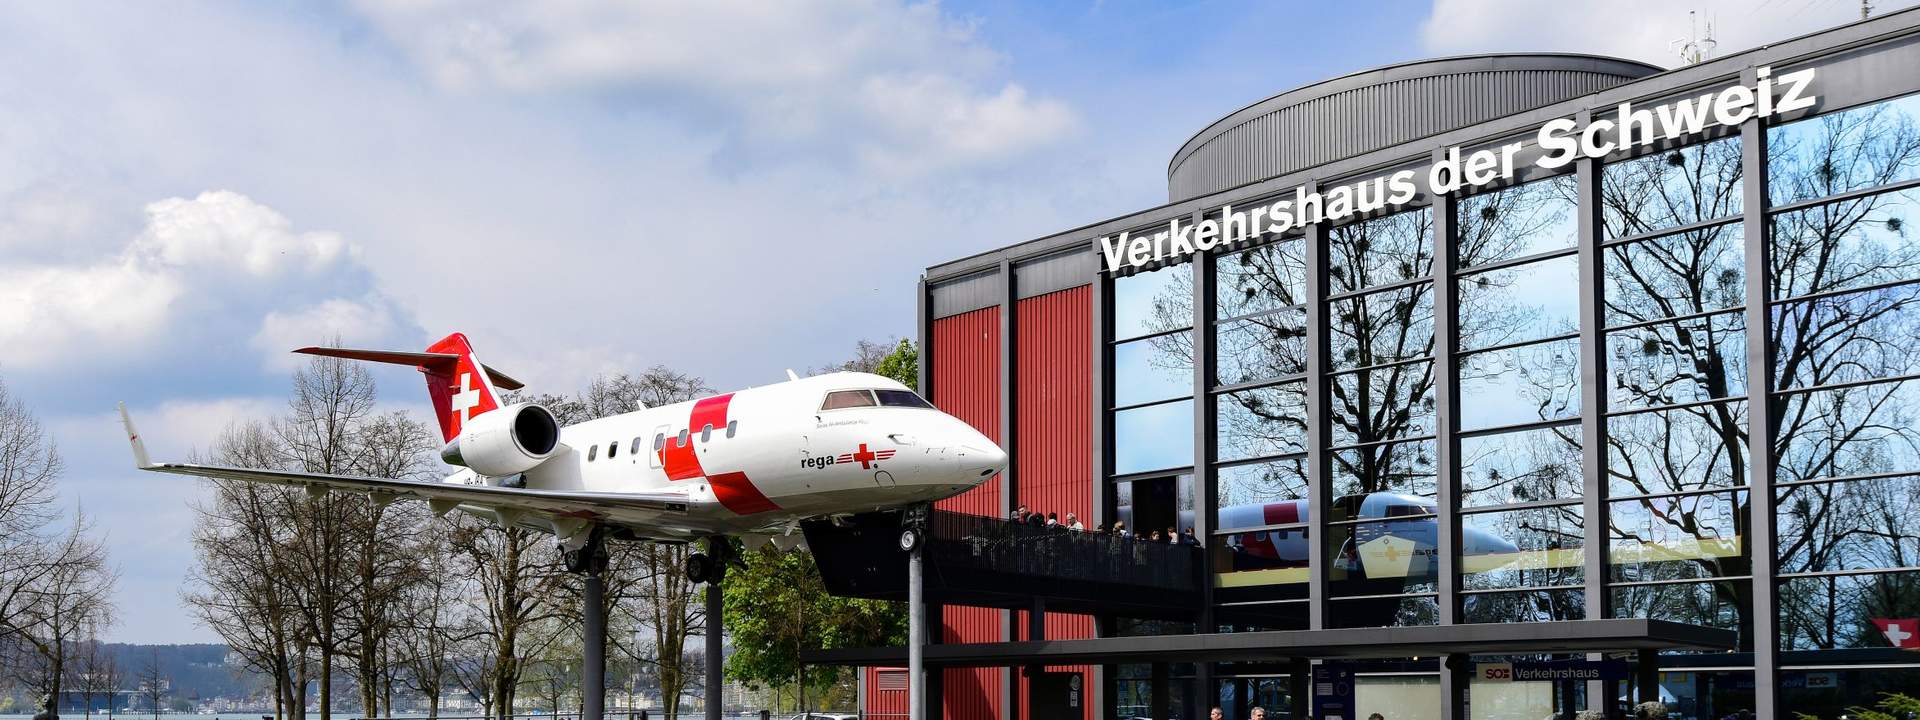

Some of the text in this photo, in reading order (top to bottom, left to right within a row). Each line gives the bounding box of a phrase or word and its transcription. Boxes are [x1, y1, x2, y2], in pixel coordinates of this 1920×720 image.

[1101, 66, 1817, 272] Verkehrshaus der Schweiz
[801, 455, 834, 470] rega
[1515, 667, 1599, 679] Verkehrshaus
